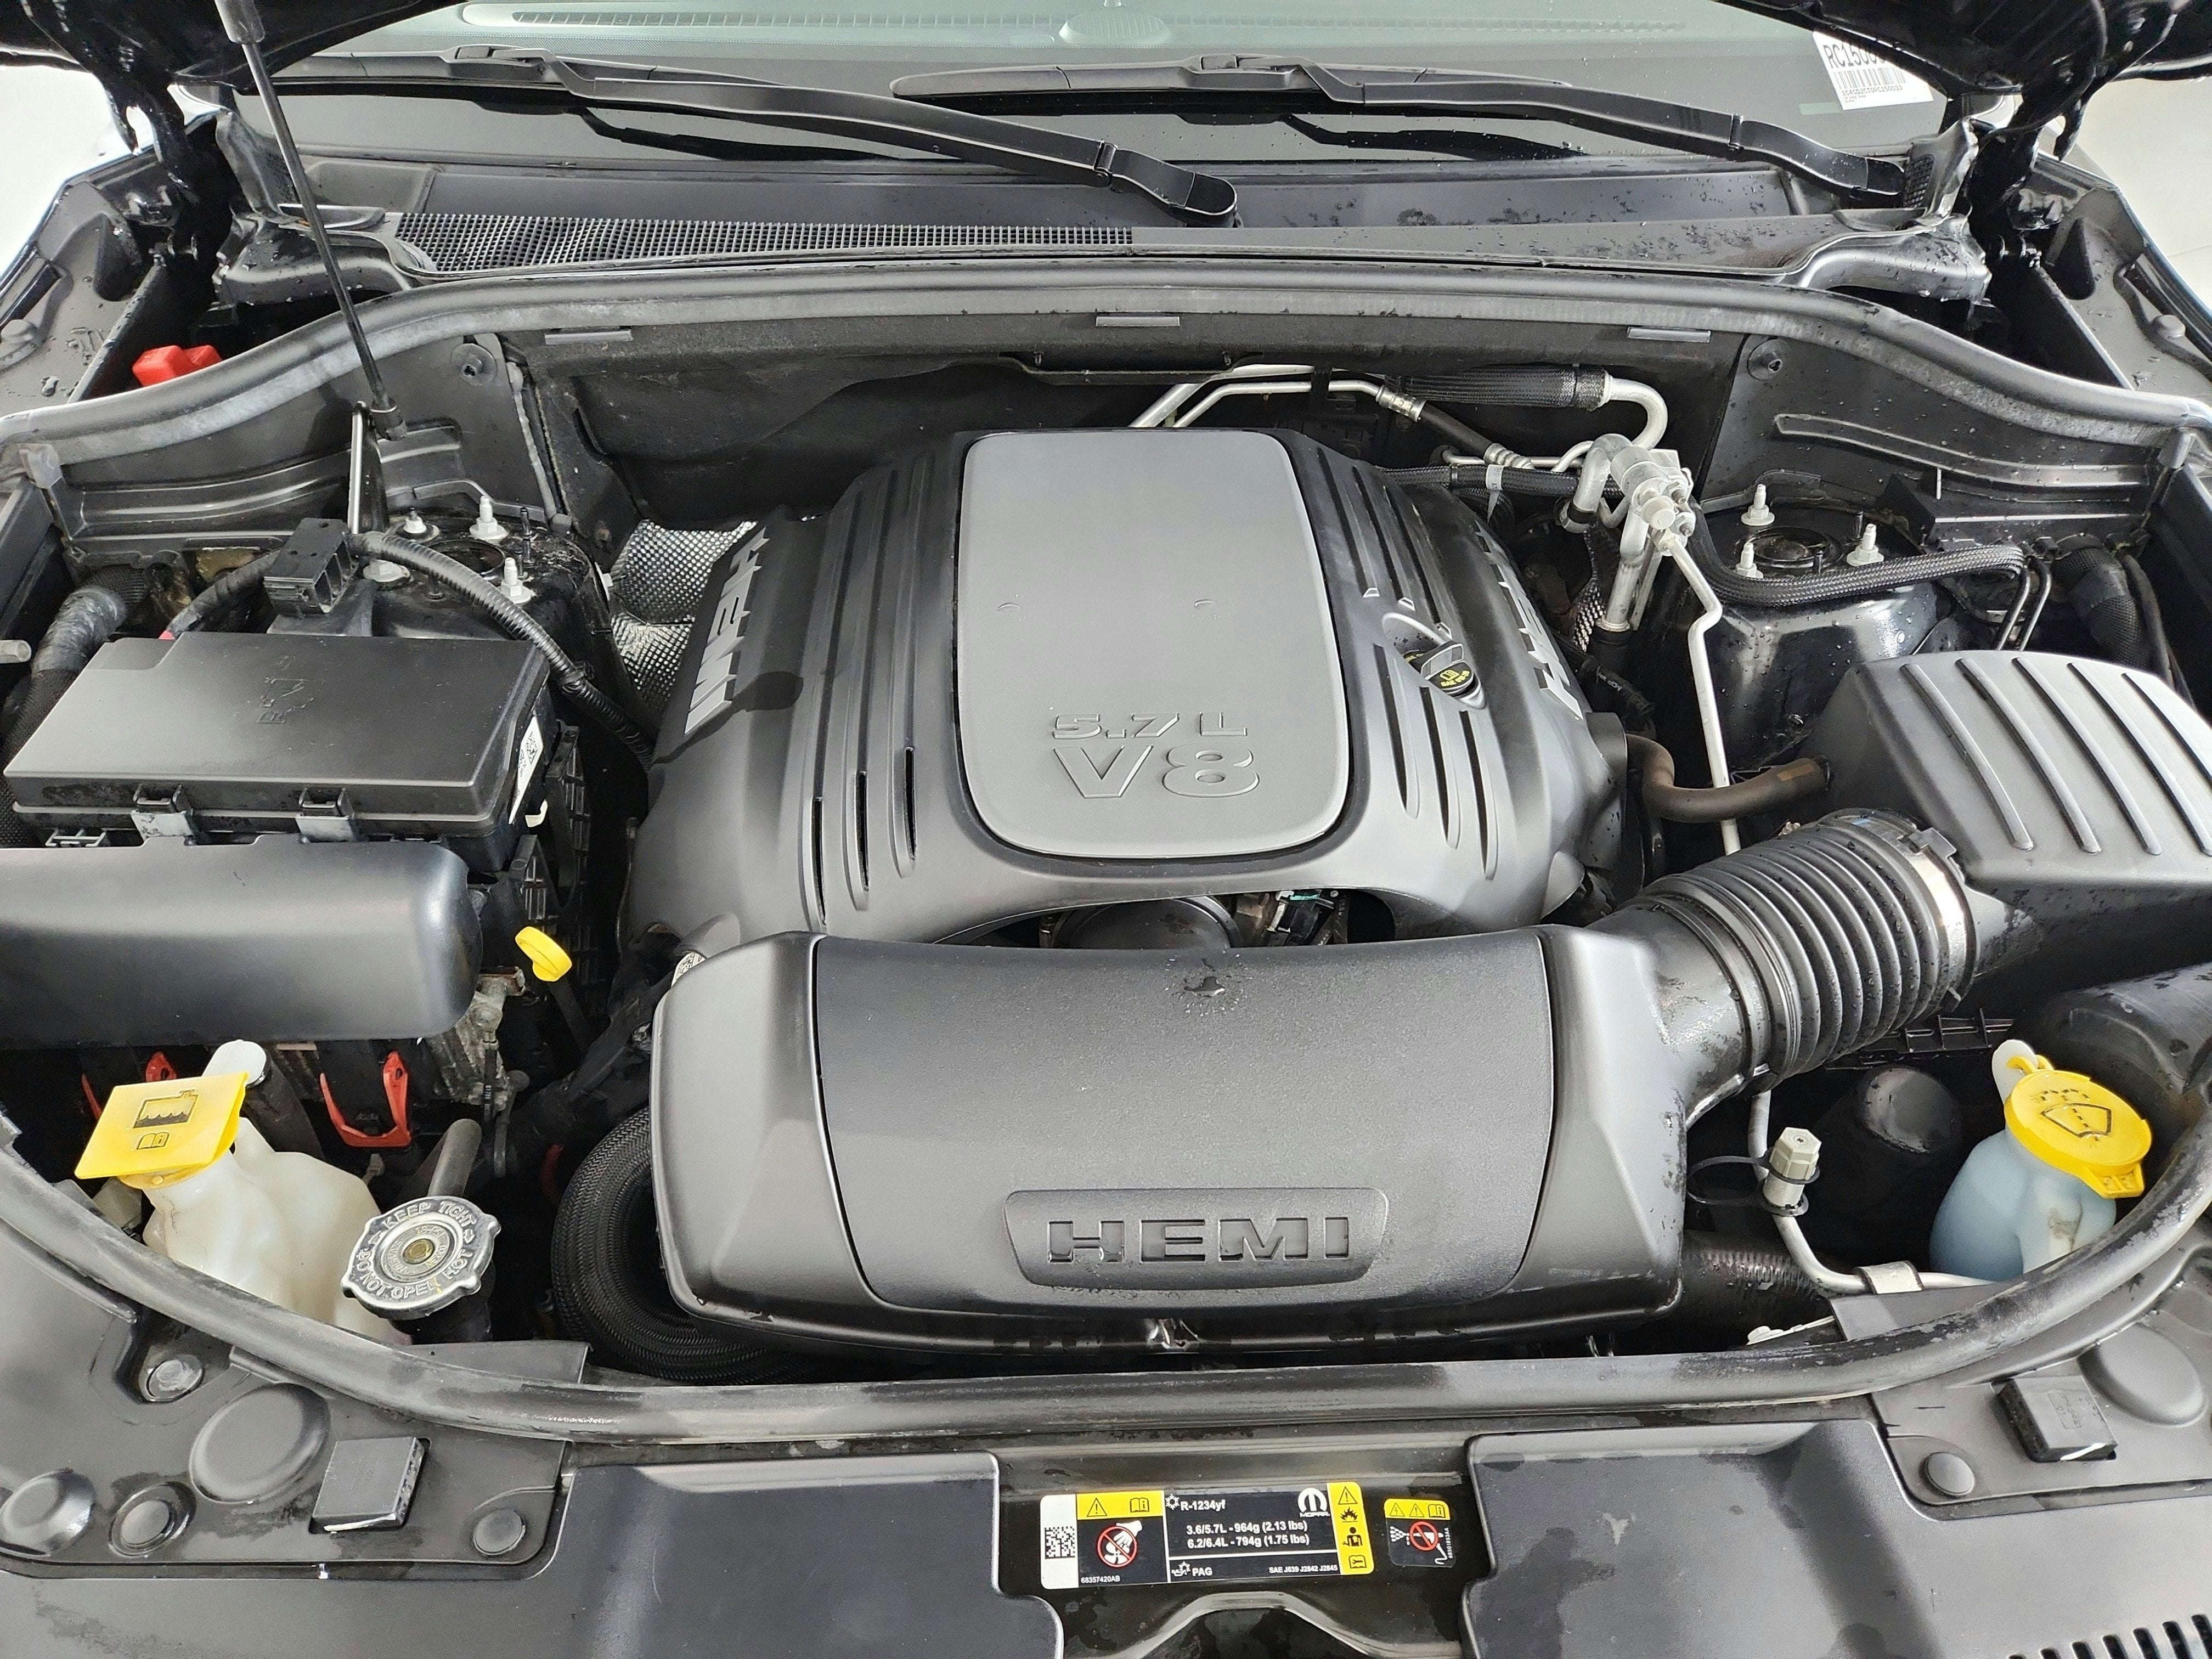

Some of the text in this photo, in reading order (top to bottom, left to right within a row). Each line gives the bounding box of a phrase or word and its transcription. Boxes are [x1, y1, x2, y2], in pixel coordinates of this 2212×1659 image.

[1052, 743, 1260, 799] V8
[382, 1200, 476, 1230] KEEP TIGHT
[1047, 1217, 1350, 1263] HEMI
[356, 1247, 374, 1272] DO
[442, 1249, 473, 1279] HOT
[359, 1272, 389, 1297] NOT
[391, 1277, 442, 1299] OPEN
[1180, 1499, 1226, 1512] R-1234yf
[1186, 1522, 1227, 1536] 3.6/5.7L
[1234, 1522, 1260, 1534] 964g
[1262, 1520, 1286, 1534] (2.13
[1289, 1520, 1308, 1532] lbs)
[1187, 1537, 1229, 1549] 6.2/6.4L
[1236, 1536, 1262, 1548] 794g
[1264, 1534, 1289, 1548] (1.75
[1290, 1533, 1310, 1546] lbs)
[1081, 1575, 1120, 1584] 68357420AB
[1192, 1567, 1213, 1577] PAG
